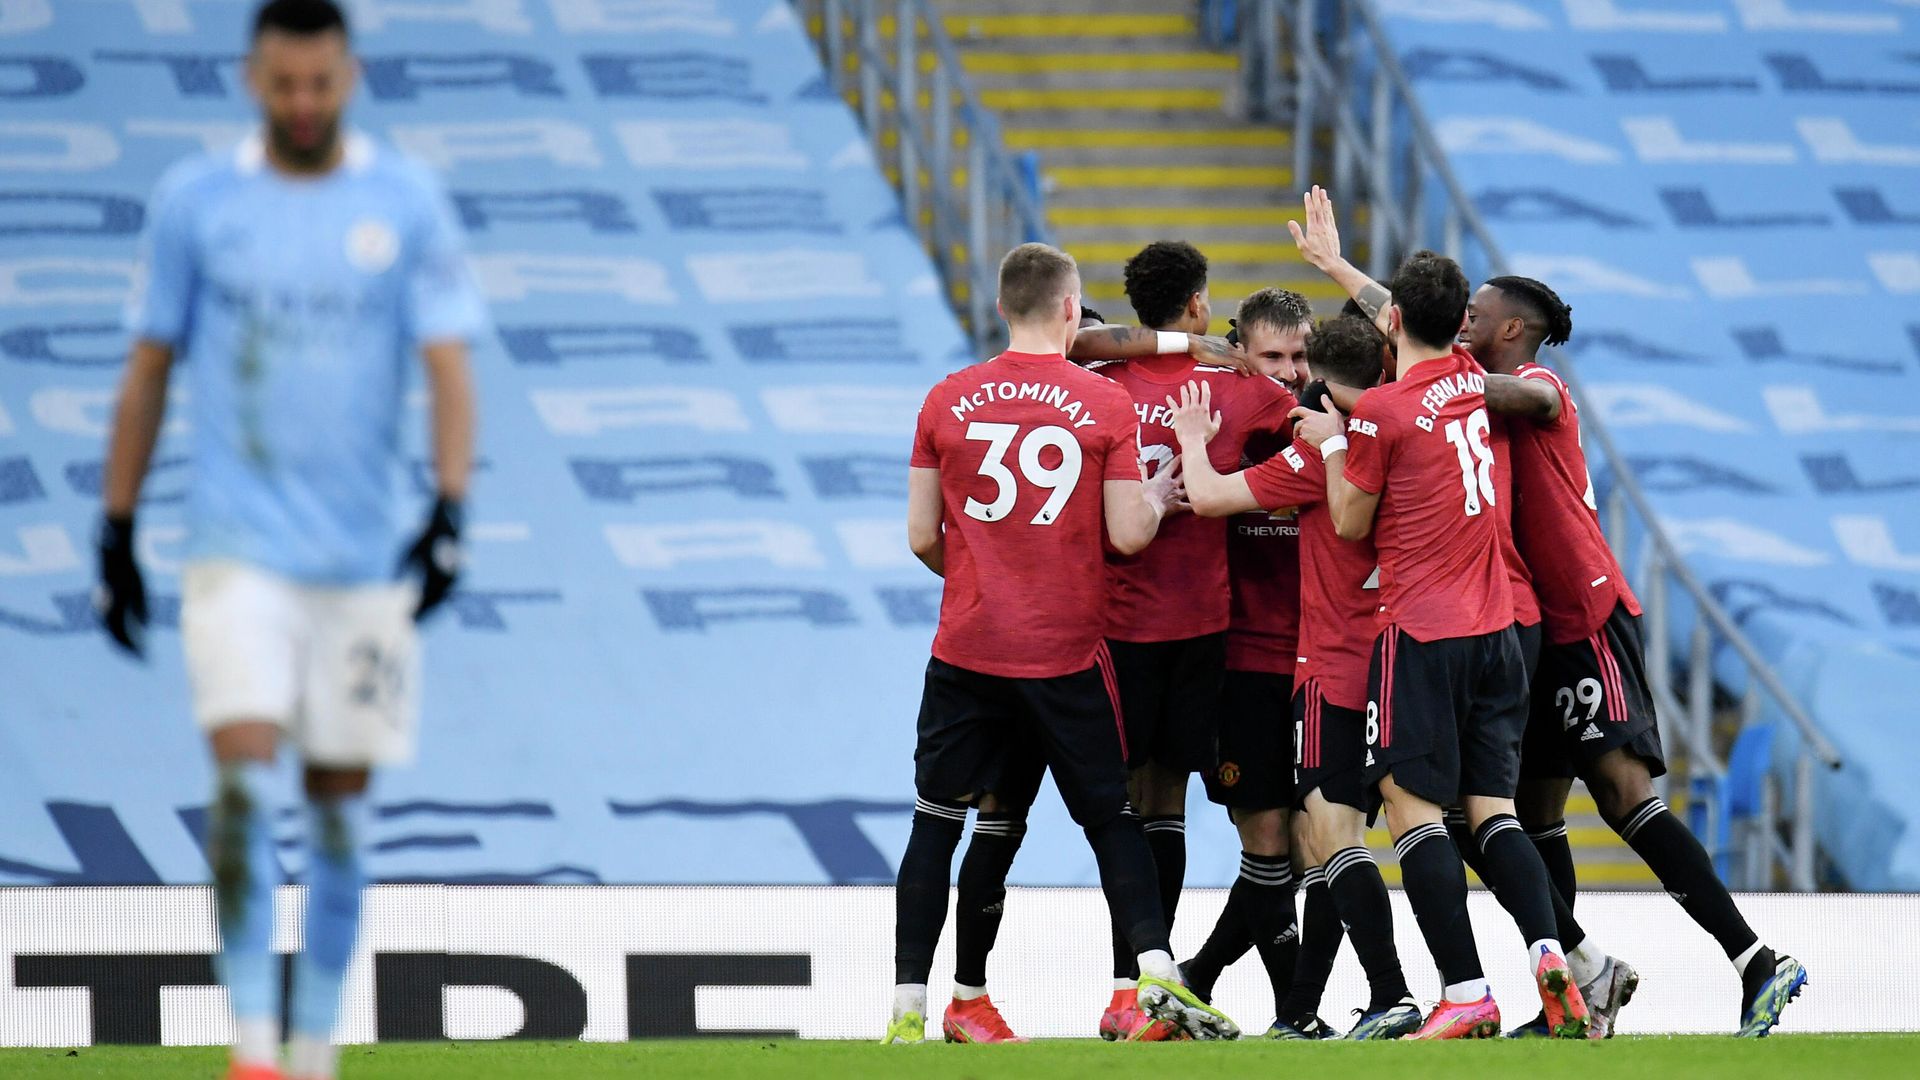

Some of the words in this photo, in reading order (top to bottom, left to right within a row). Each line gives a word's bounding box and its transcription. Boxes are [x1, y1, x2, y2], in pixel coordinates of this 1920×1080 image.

[951, 382, 1096, 429] McTOMINAY
[964, 421, 1083, 525] 39
[1445, 408, 1495, 516] 18
[1556, 677, 1603, 732] 29
